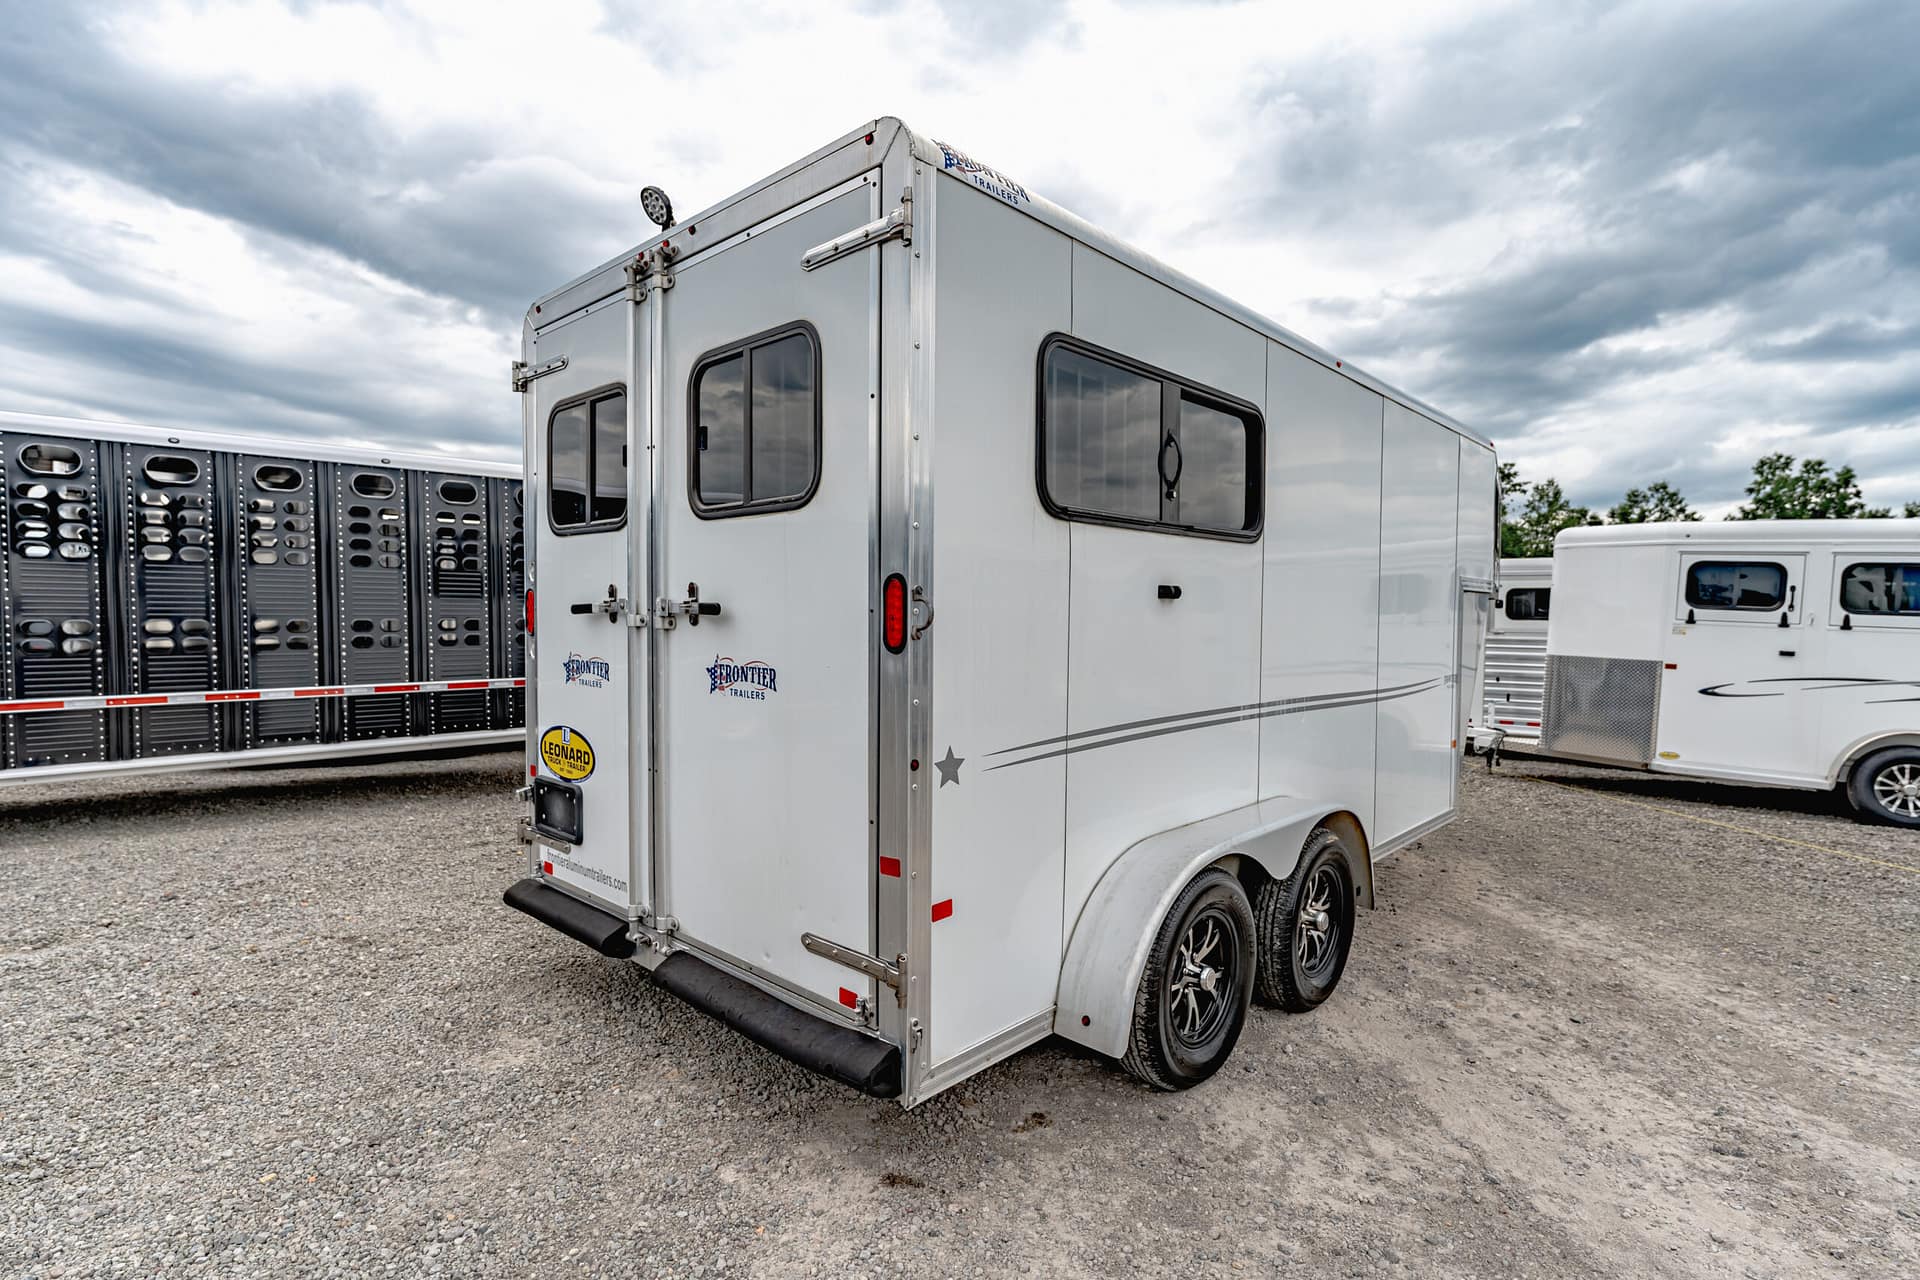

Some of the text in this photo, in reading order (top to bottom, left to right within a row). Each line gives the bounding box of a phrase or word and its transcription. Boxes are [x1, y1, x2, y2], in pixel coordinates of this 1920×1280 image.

[973, 174, 1019, 205] TRAILERS
[571, 659, 610, 682] FRONTIER
[719, 663, 777, 693] FRONTIER
[578, 678, 603, 689] TRAILERS
[730, 688, 766, 701] TRAILERS
[544, 740, 590, 766] LEONARD
[548, 755, 561, 766] TRUCK
[567, 760, 586, 773] TRAILER
